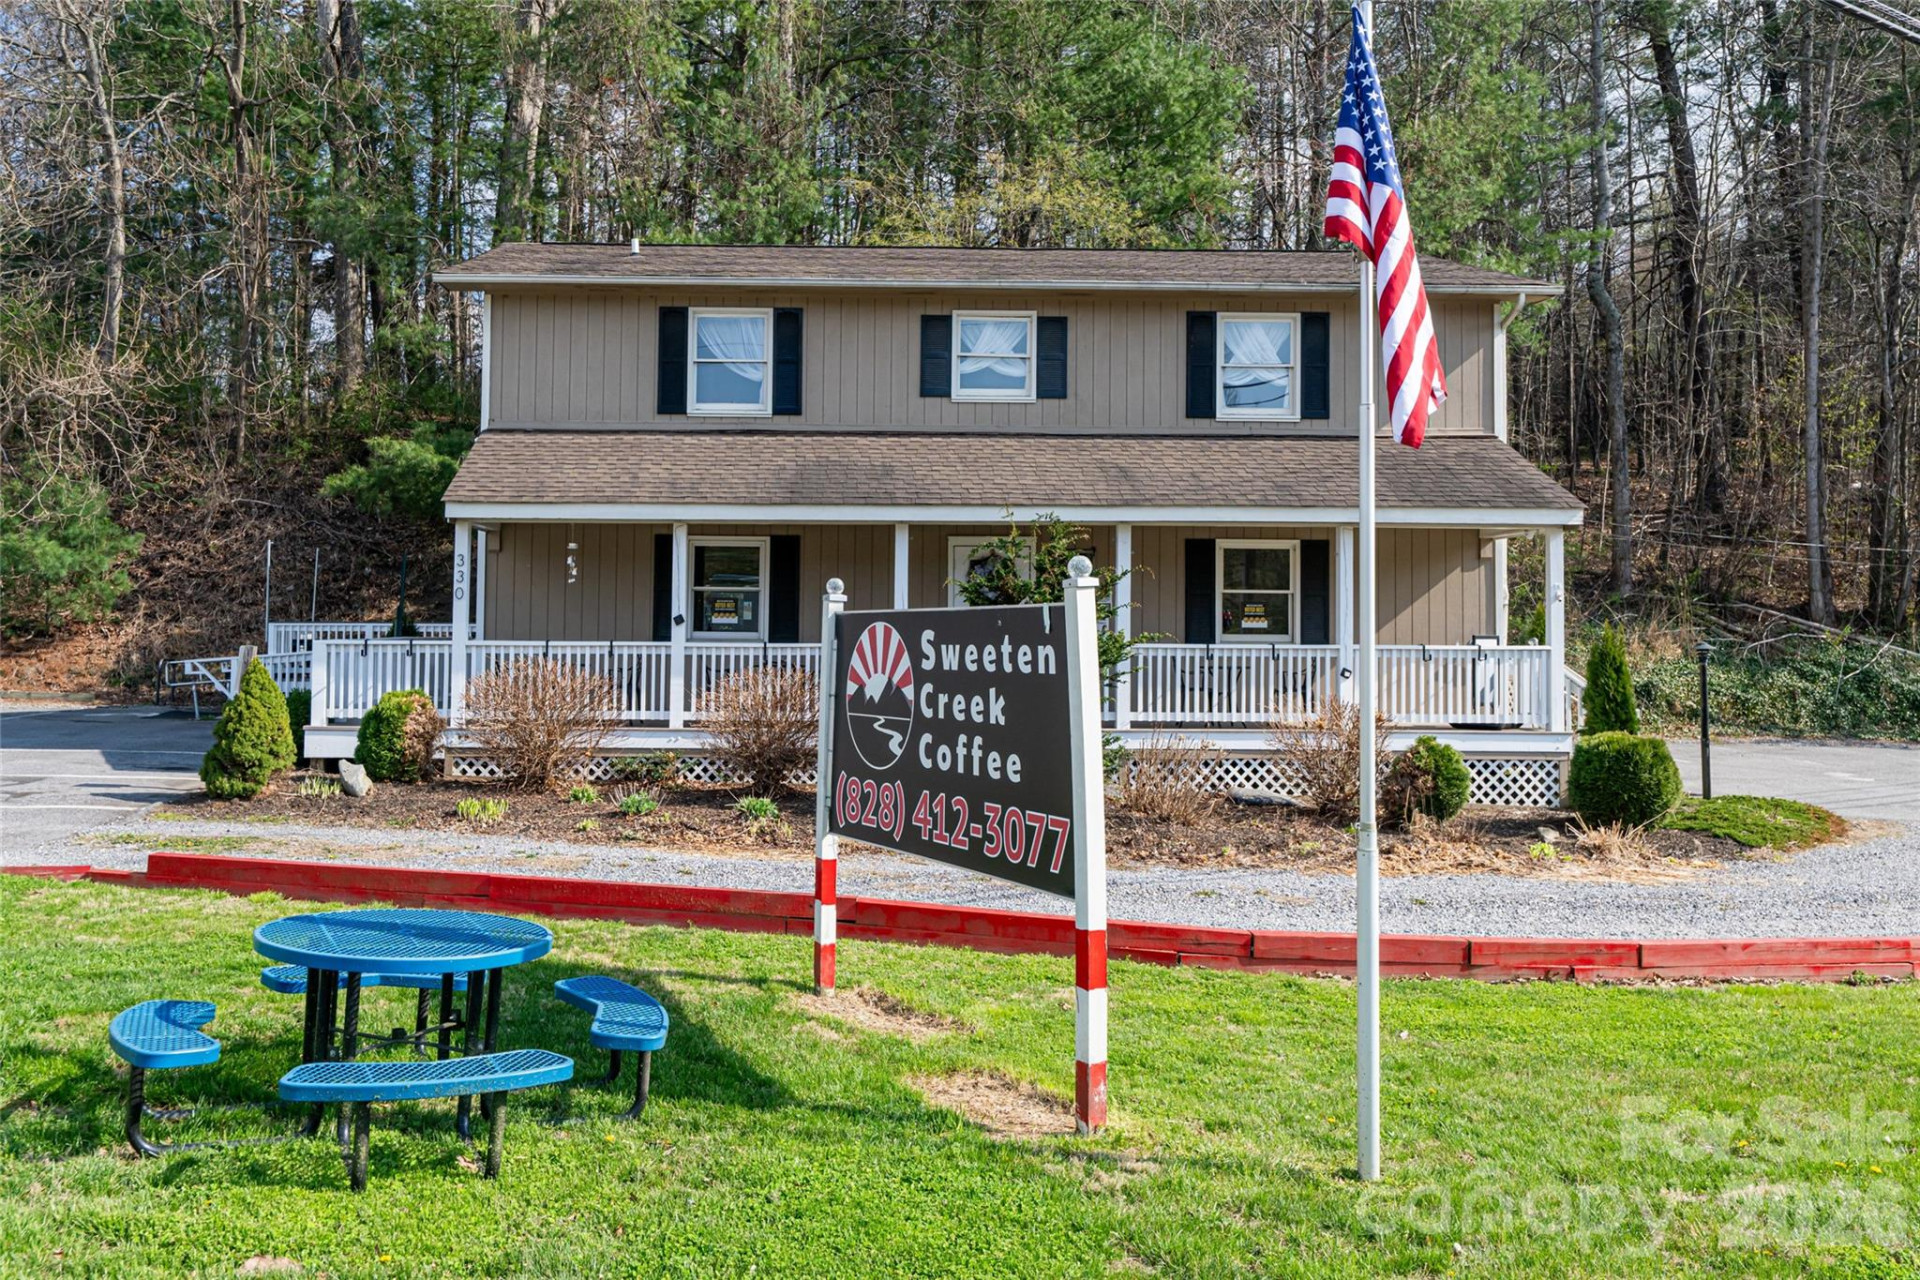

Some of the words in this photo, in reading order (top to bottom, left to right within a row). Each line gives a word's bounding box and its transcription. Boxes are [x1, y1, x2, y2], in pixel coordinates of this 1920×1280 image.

[455, 553, 465, 600] 330
[920, 629, 1056, 675] Sweeten
[919, 682, 1006, 726] Creek
[919, 732, 1022, 783] Coffee
[835, 770, 905, 842] (828)
[912, 790, 1071, 874] 412-3077
